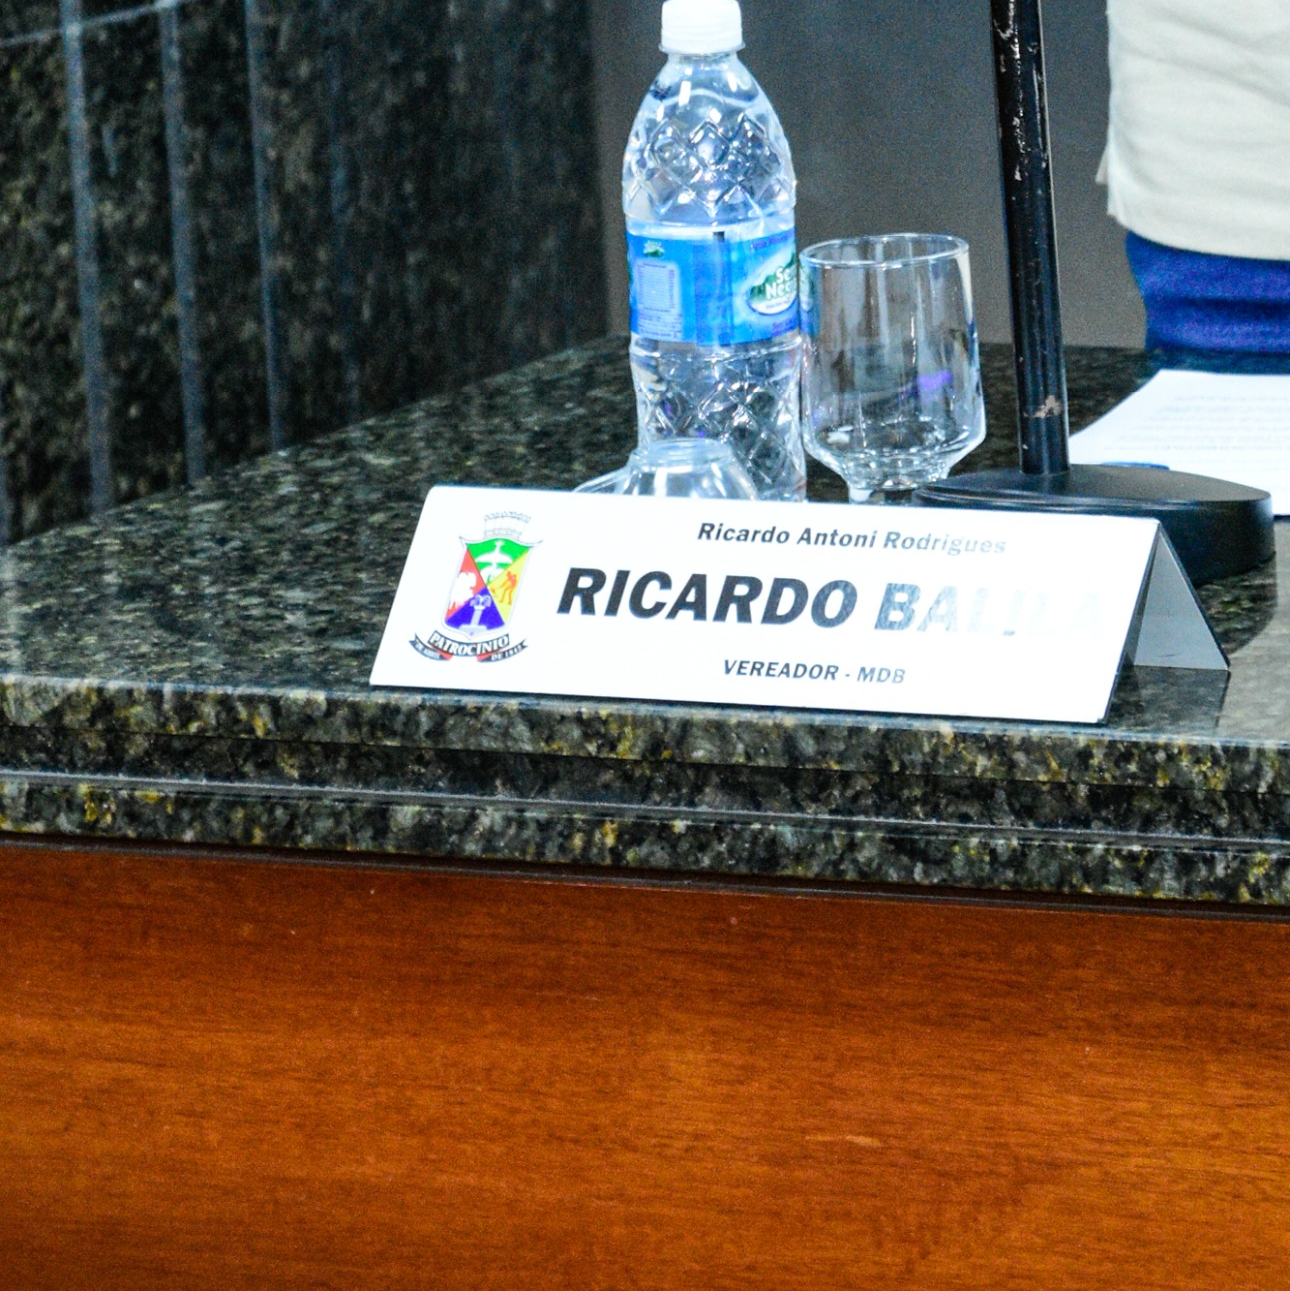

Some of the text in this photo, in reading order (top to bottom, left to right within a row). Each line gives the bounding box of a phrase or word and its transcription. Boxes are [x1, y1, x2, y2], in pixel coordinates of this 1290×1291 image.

[696, 522, 1006, 557] Ricardo Antoni Rodrigues
[556, 567, 858, 629] RICARDO
[723, 659, 840, 681] VEREADOR
[856, 665, 906, 685] MDB
